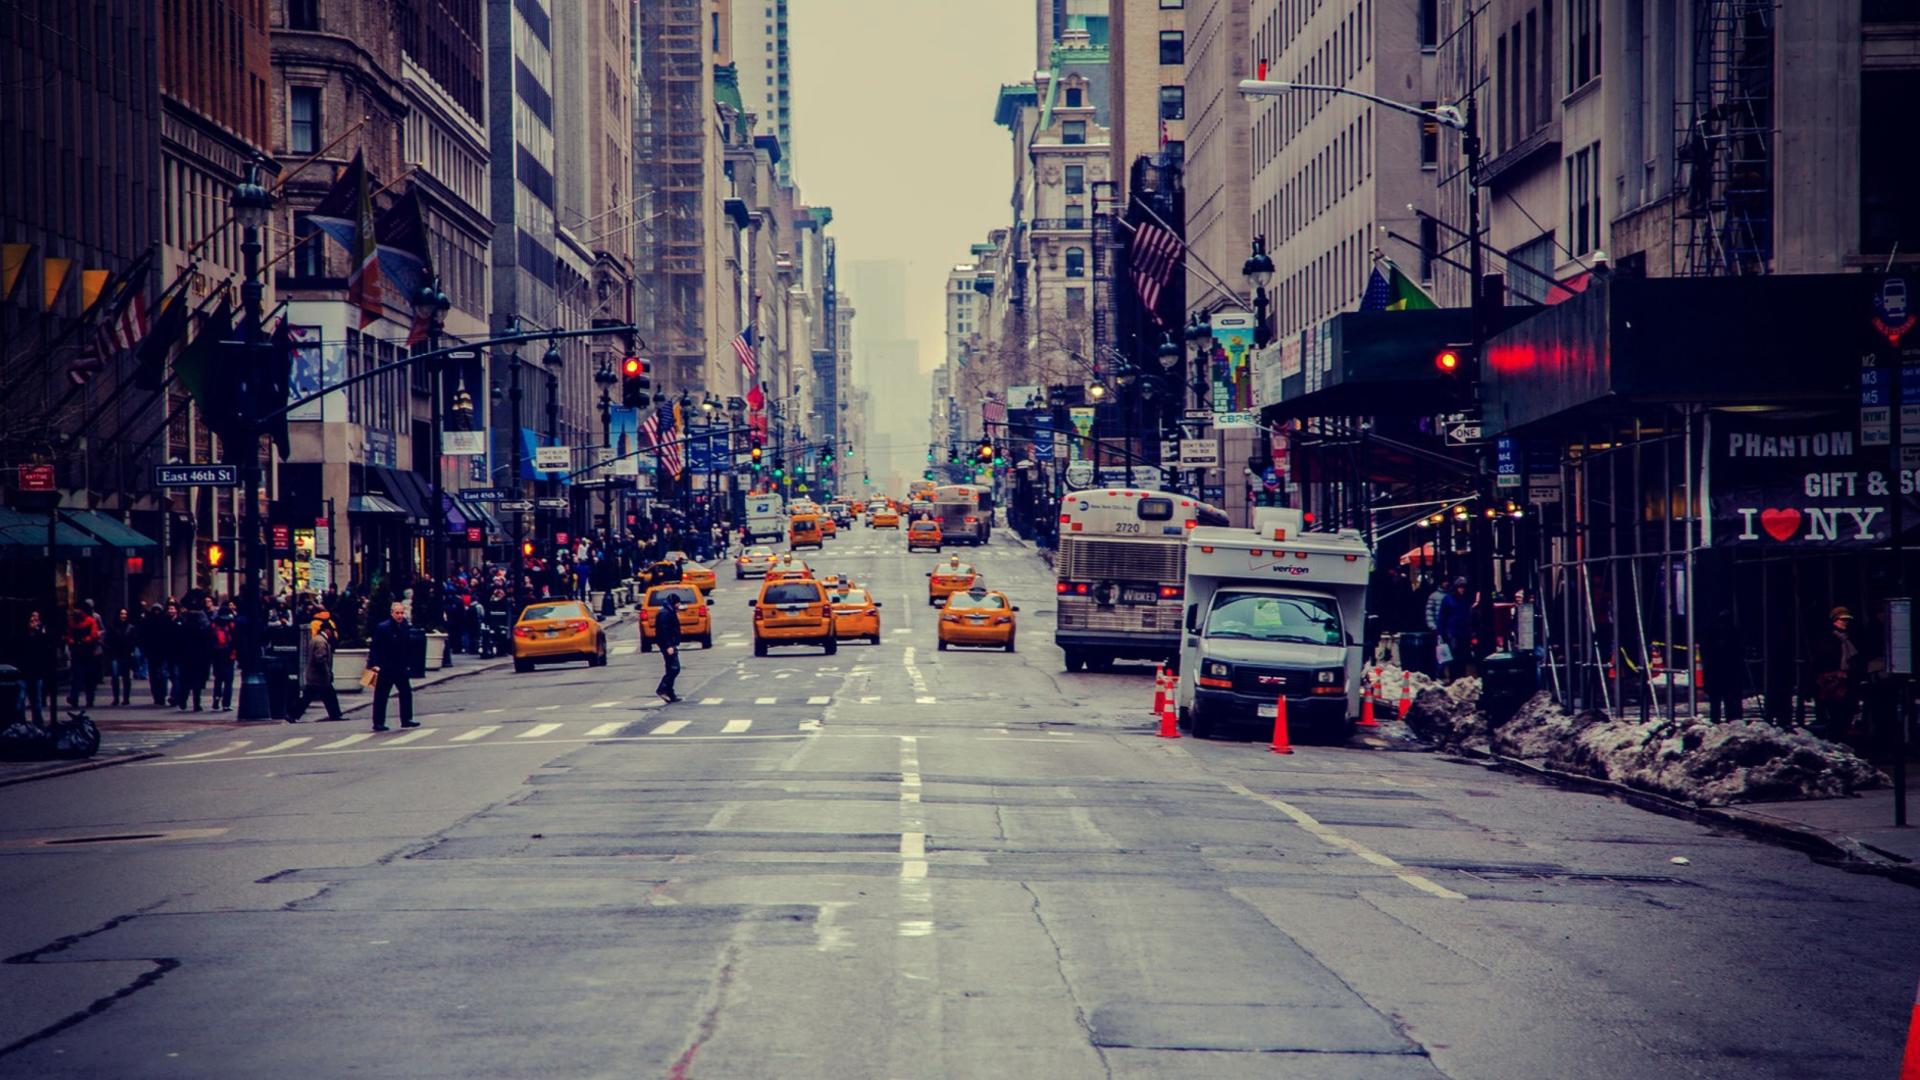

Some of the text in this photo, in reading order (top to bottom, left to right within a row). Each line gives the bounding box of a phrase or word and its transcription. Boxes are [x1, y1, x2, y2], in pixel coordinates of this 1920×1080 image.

[1862, 353, 1875, 367] M2
[1862, 370, 1877, 385] M3
[1862, 390, 1878, 404] M5
[1456, 428, 1476, 438] ONE
[1729, 431, 1853, 457] PHANTOM
[162, 469, 231, 482] East 46th St
[1804, 472, 1858, 497] GIFT
[1866, 470, 1890, 496] &
[1116, 522, 1140, 532] 2720
[1737, 507, 1760, 541] I
[1273, 564, 1309, 575] verizon
